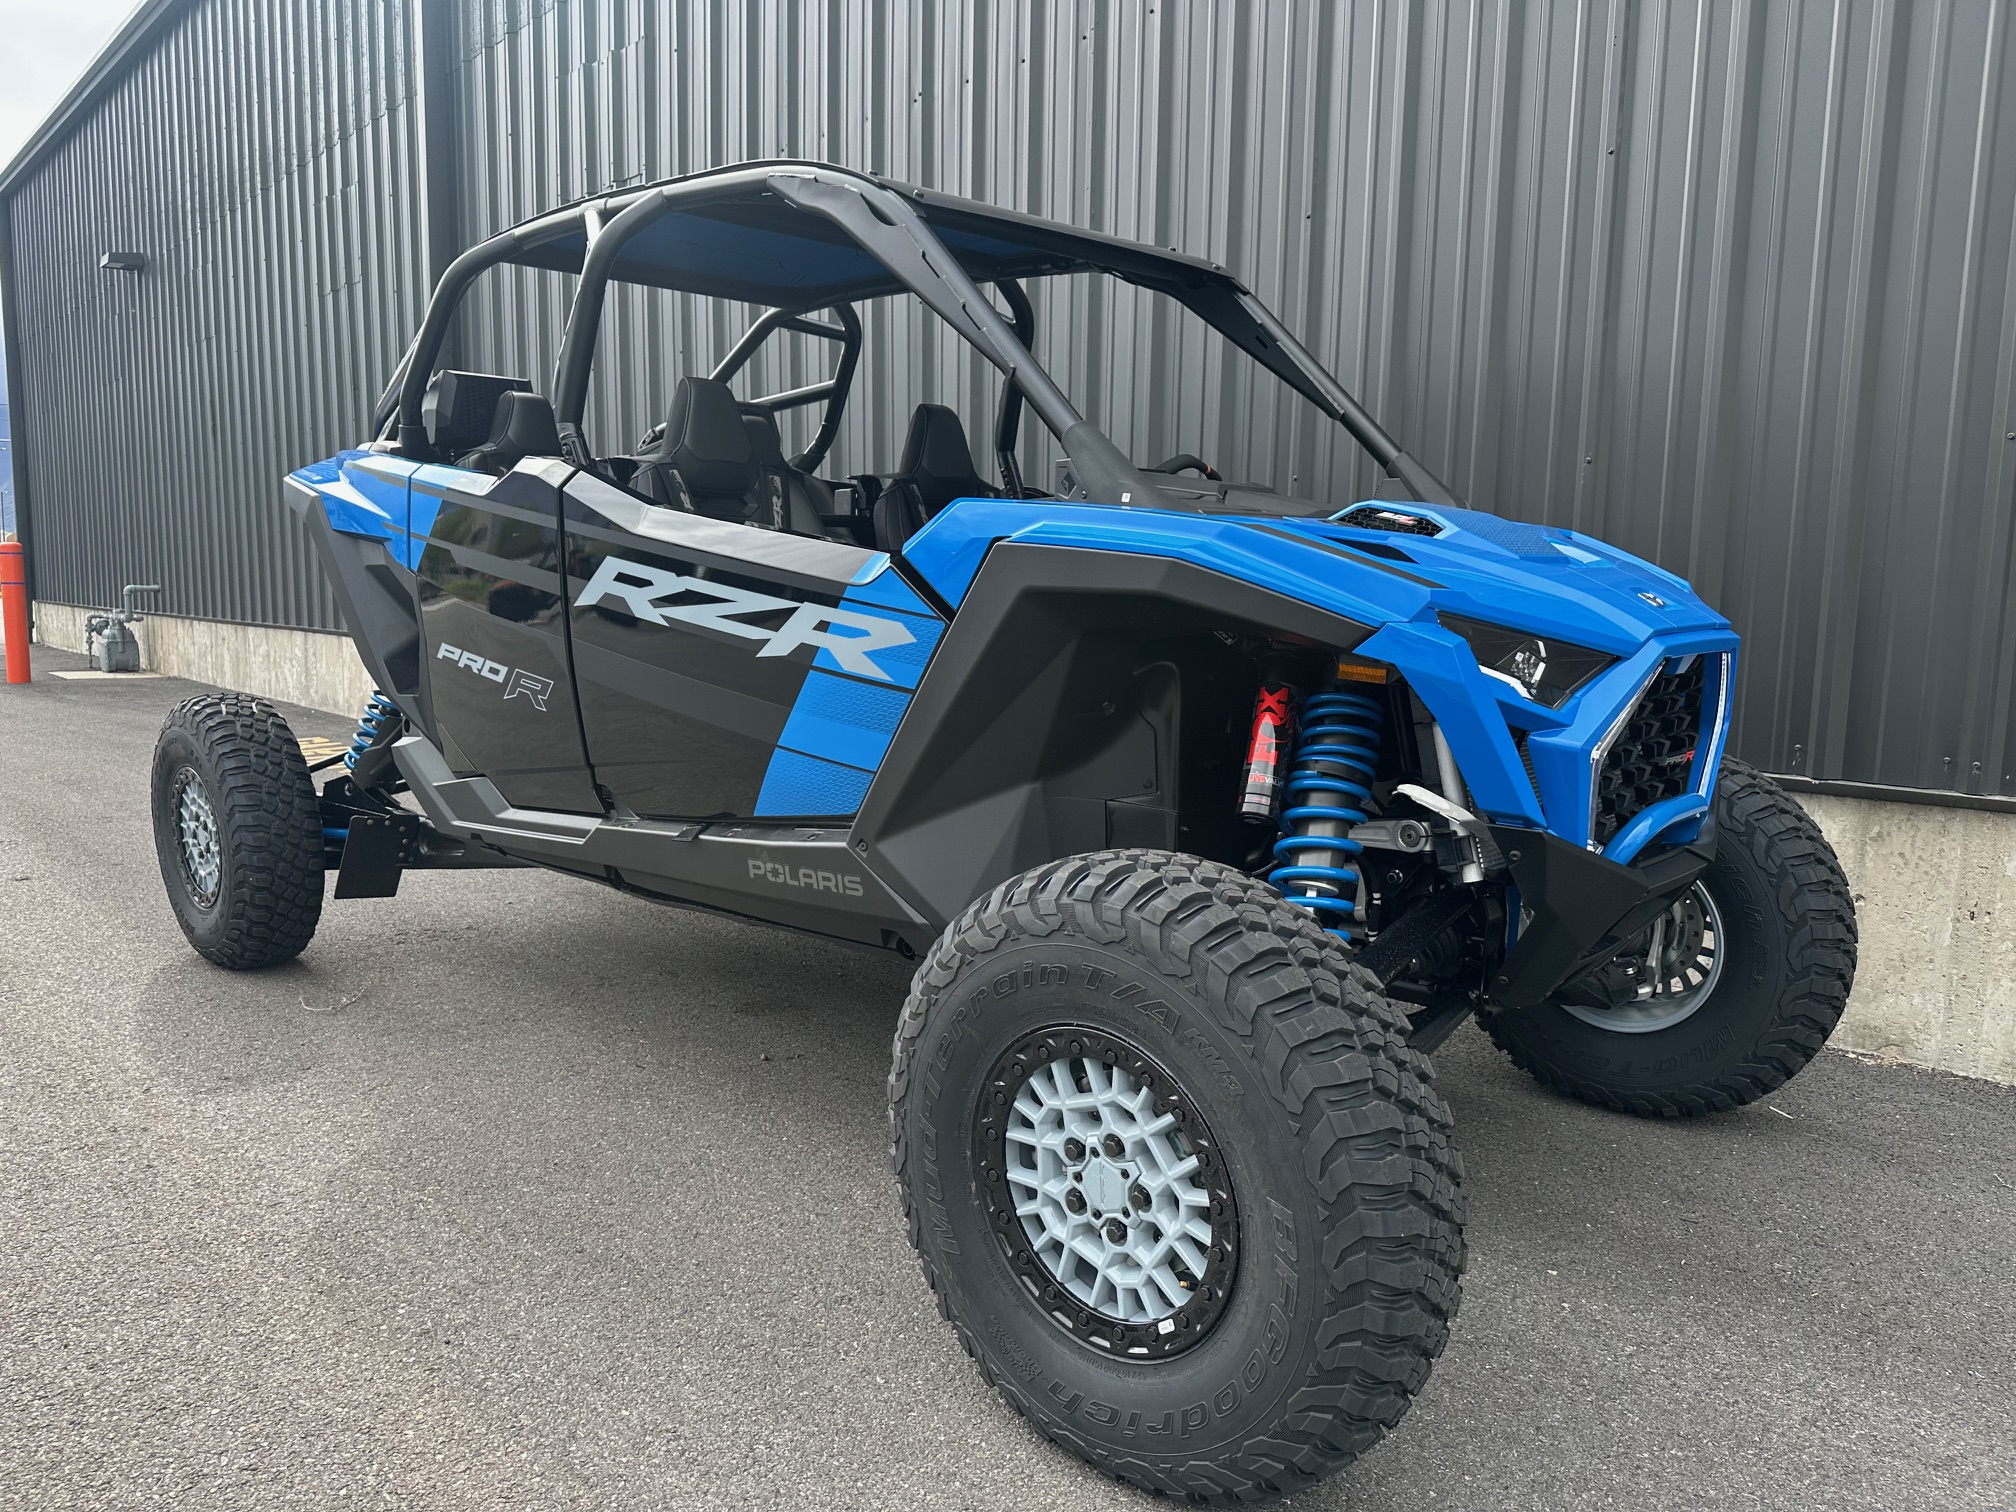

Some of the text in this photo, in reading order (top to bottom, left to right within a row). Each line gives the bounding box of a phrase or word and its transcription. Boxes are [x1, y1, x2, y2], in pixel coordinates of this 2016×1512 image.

[574, 555, 918, 682] RZR
[437, 642, 555, 712] PRO R
[1247, 686, 1289, 766] FOX
[748, 859, 864, 897] POLARIS
[918, 960, 1070, 1256] Mud-Terrain
[1046, 1195, 1300, 1440] BFGoodrich
